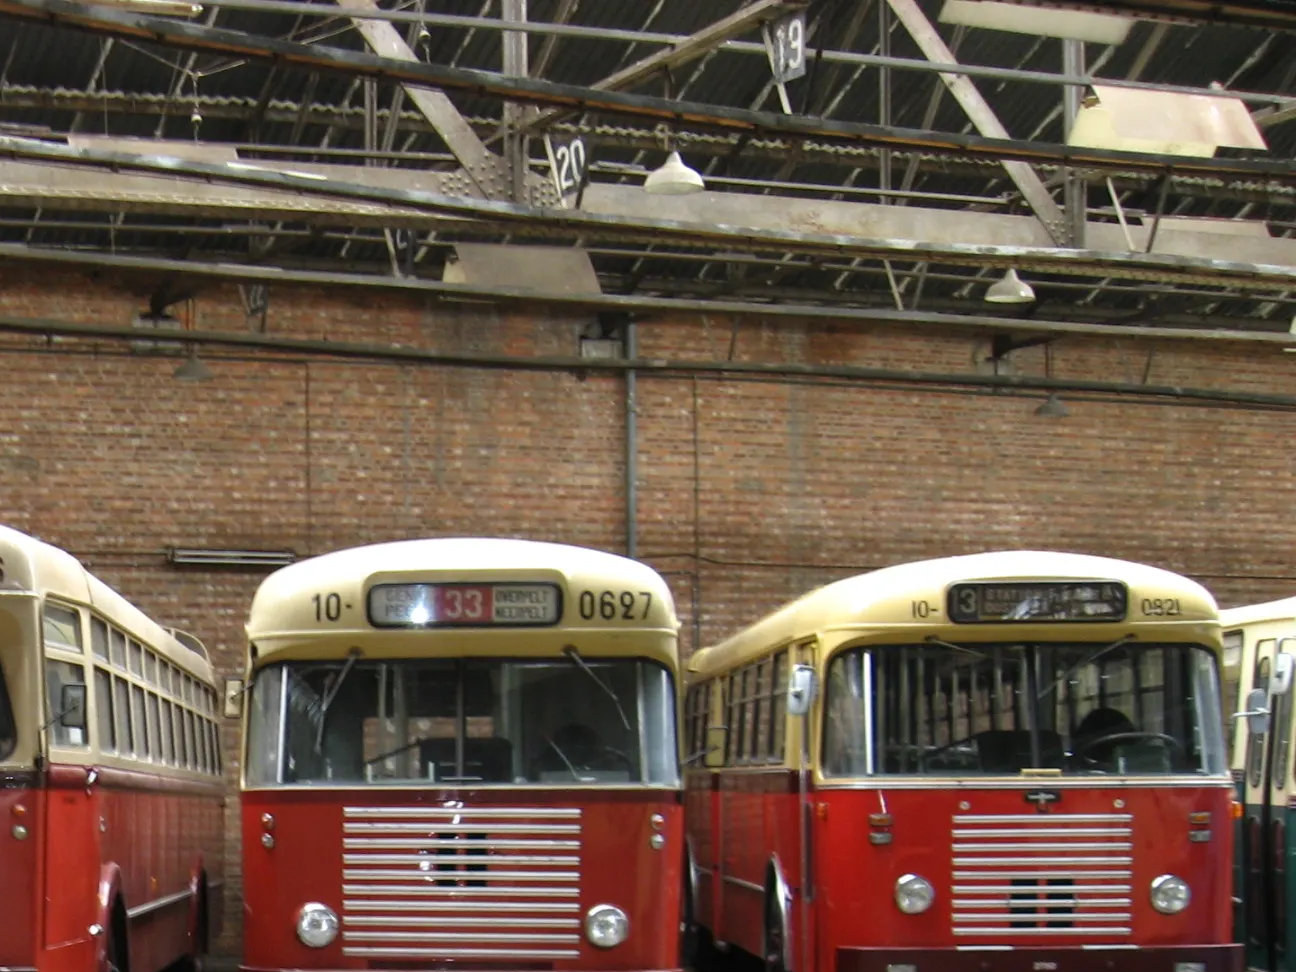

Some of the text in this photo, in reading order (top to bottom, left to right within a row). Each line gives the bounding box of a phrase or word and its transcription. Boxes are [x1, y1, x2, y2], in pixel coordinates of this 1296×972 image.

[776, 19, 802, 72] 19
[556, 139, 586, 190] 20
[445, 589, 483, 618] 33
